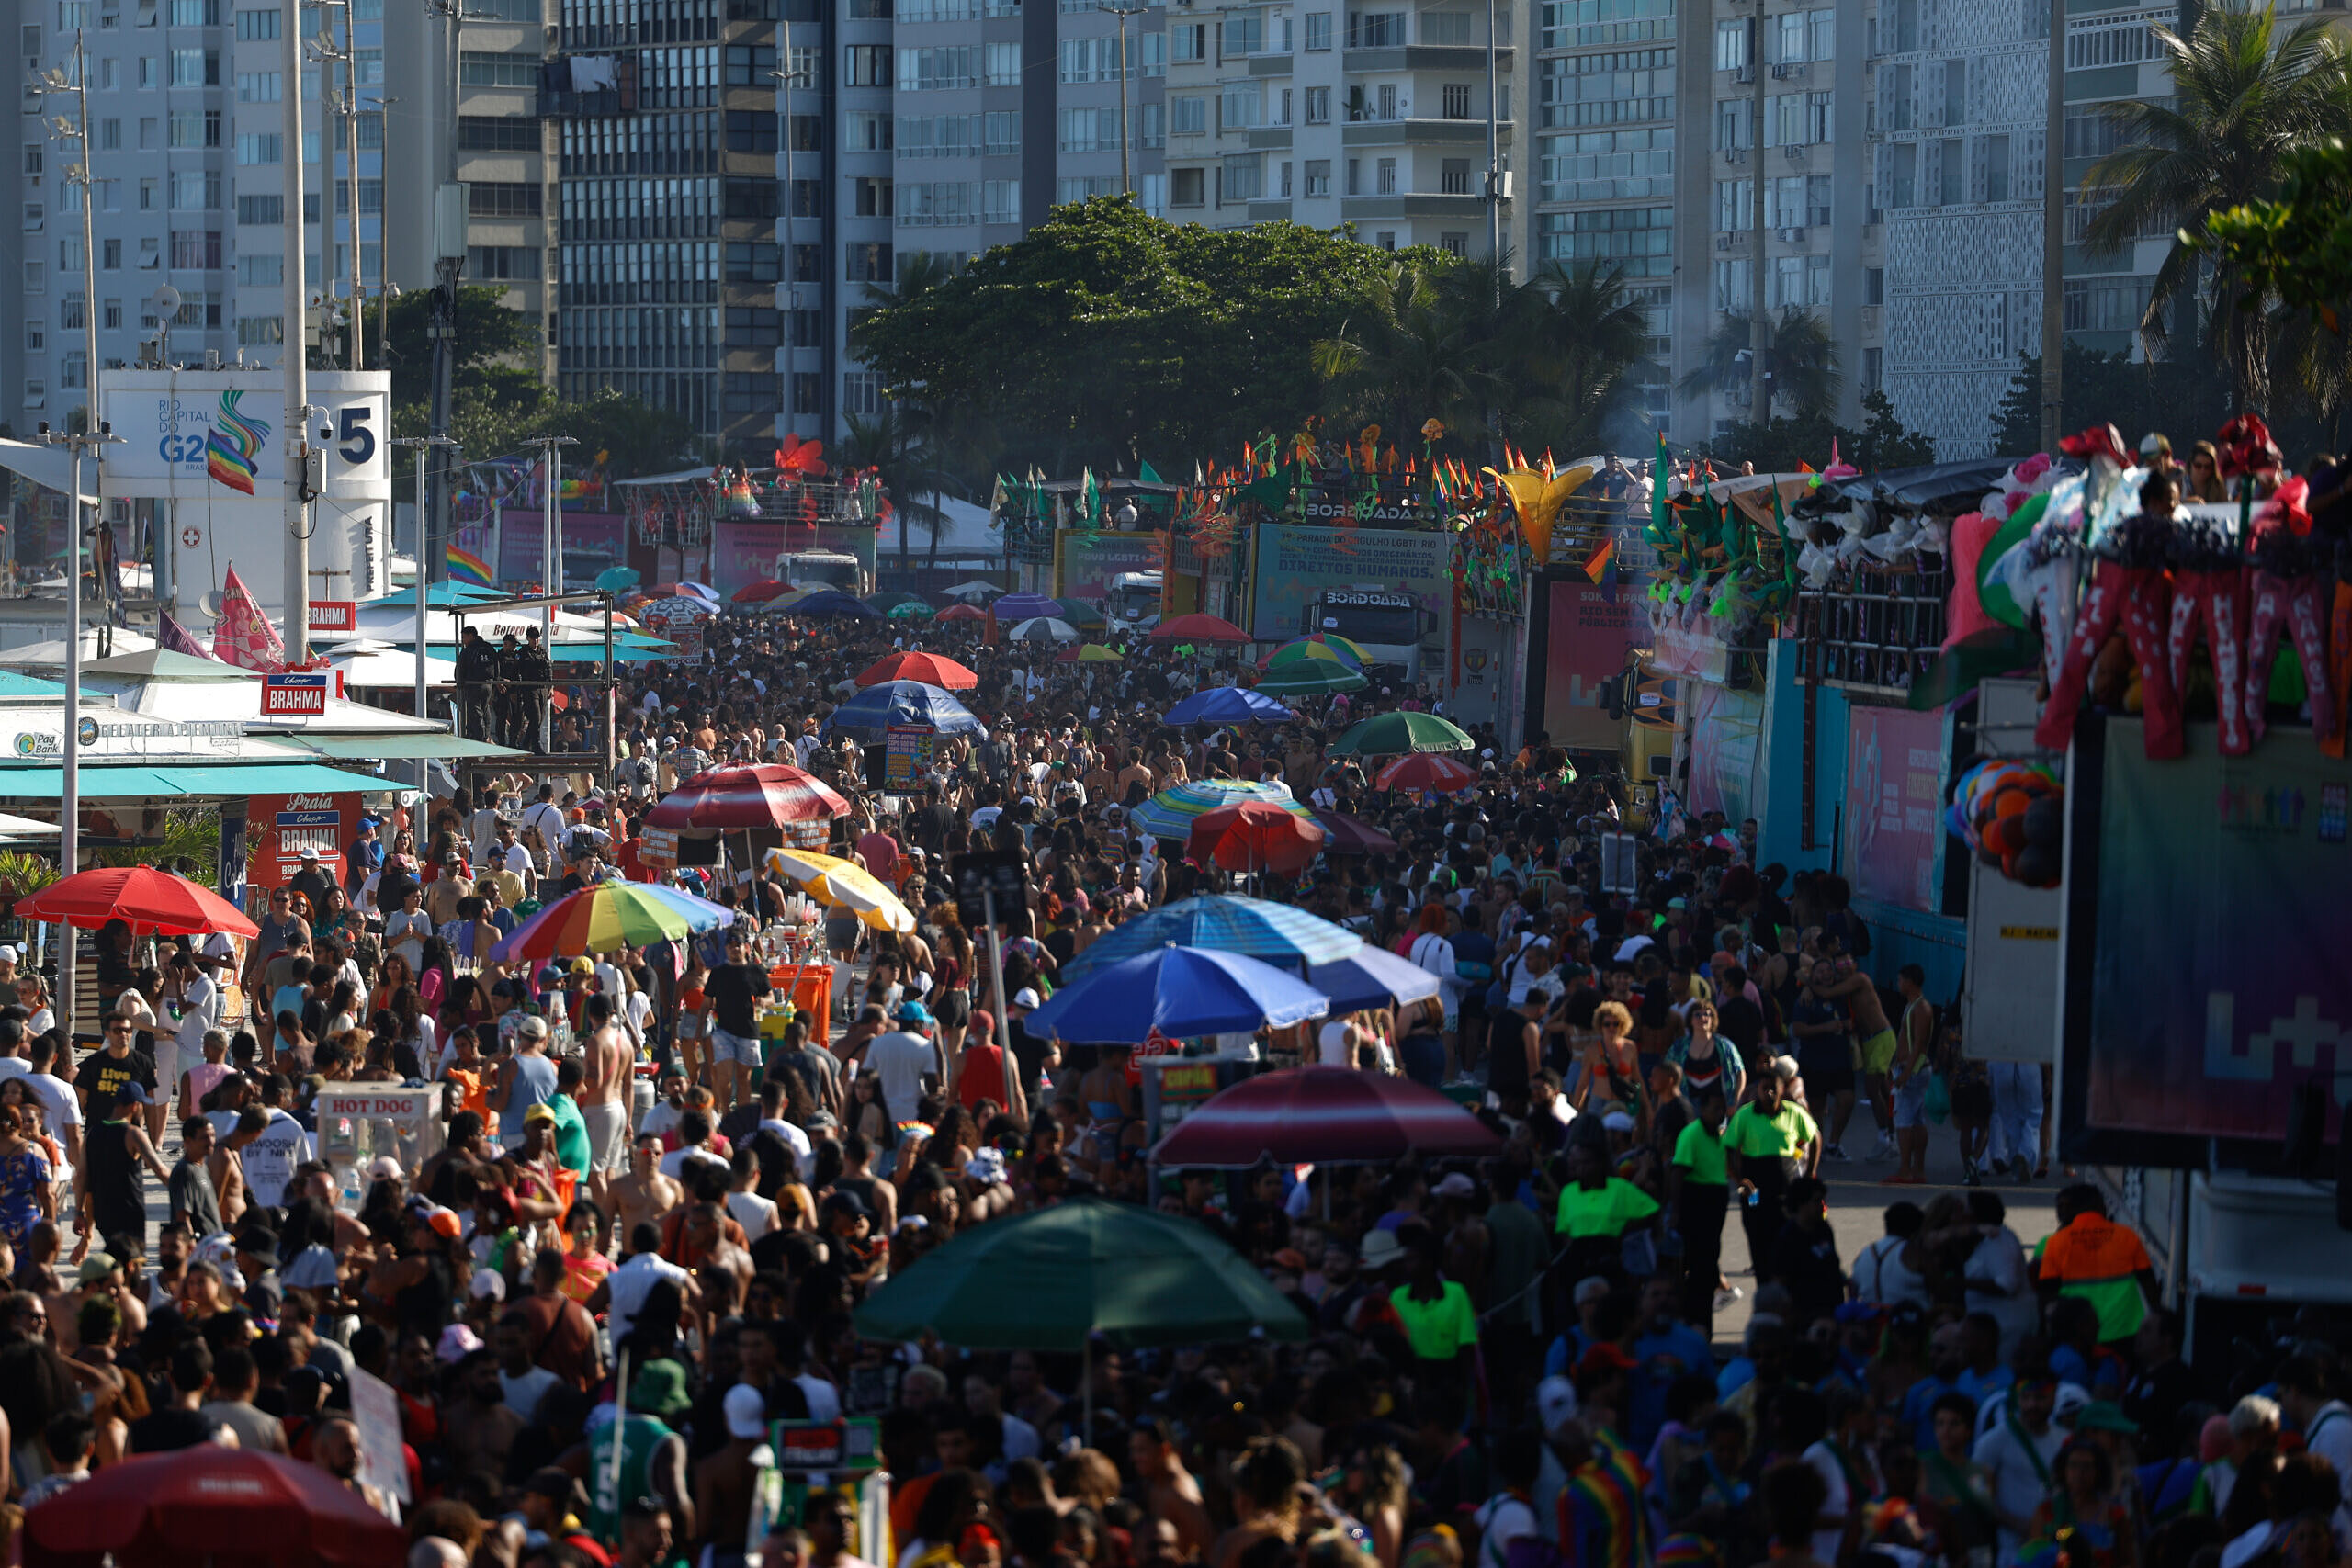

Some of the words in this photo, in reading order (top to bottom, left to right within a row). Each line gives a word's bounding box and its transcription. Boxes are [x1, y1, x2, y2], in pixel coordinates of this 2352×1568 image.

[159, 400, 181, 411] RIO
[159, 411, 212, 423] CAPITAL
[159, 422, 178, 434] DO
[338, 407, 375, 465] 5
[1306, 503, 1413, 521] BORDOADA
[1421, 540, 1436, 548] RIO
[364, 515, 375, 592] PREFEITURA
[1279, 559, 1353, 575] DIREITOS
[1357, 564, 1435, 580] HUMANOS.
[1327, 592, 1411, 608] BORDOADA
[308, 607, 346, 625] BRAHMA
[1580, 605, 1602, 616] RIO
[492, 624, 526, 637] Boteco
[269, 690, 322, 709] BRAHMA
[100, 723, 175, 738] GELATERIA
[177, 721, 246, 737] PIEMONTE
[37, 734, 55, 745] Pag
[35, 744, 59, 754] Bank
[286, 793, 334, 811] Praia
[296, 814, 326, 823] Chopp
[280, 829, 337, 852] BRAHMA
[281, 864, 305, 875] BRAH
[100, 1067, 132, 1081] Live
[333, 1099, 370, 1113] HOT
[375, 1099, 413, 1113] DOG
[246, 1149, 261, 1158] BY
